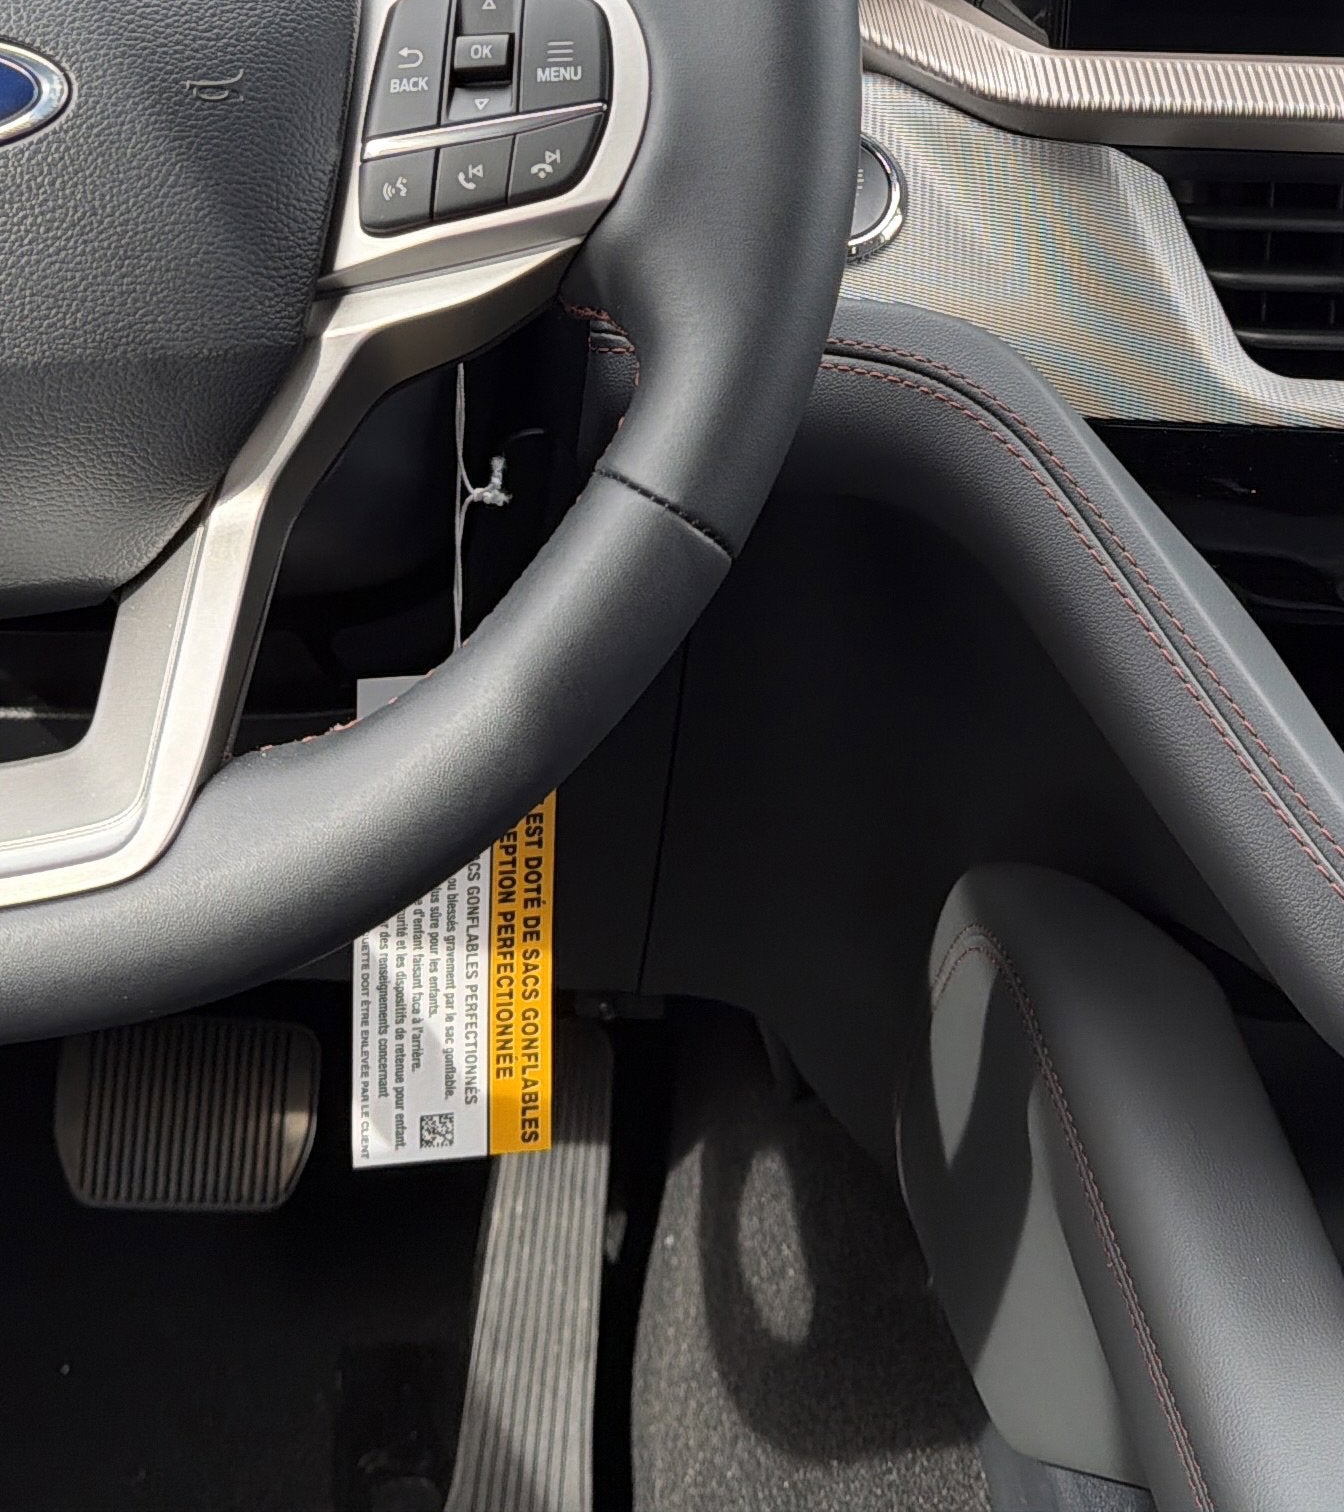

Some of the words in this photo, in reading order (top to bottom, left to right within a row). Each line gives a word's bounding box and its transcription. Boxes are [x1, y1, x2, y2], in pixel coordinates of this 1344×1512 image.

[470, 44, 492, 59] OK
[389, 76, 429, 94] BACK
[536, 66, 582, 82] MENU
[525, 813, 544, 849] EST
[498, 830, 517, 904] EPTION
[523, 856, 546, 910] DOTÉ
[430, 888, 441, 904] lus
[446, 893, 459, 931] blessés
[396, 912, 409, 938] urité
[413, 909, 426, 951] d'enfant
[430, 906, 442, 929] sûre
[466, 886, 480, 979] GONFLABLES
[522, 915, 541, 942] DE
[360, 937, 370, 971] UETTE
[378, 931, 391, 951] des
[396, 940, 407, 951] et
[427, 932, 439, 955] pour
[396, 954, 408, 969] les
[412, 954, 425, 990] faisant
[429, 958, 441, 974] les
[443, 935, 457, 990] gravement
[521, 948, 540, 1001] SACS
[360, 973, 370, 998] DOIT
[376, 953, 391, 1036] renseignements
[393, 972, 408, 1025] dispositifs
[429, 977, 441, 1018] enfants.
[443, 993, 455, 1009] par
[496, 910, 518, 1080] PERFECTIONNÉE
[360, 1000, 372, 1028] ÊTRE
[412, 992, 424, 1015] face
[445, 1013, 457, 1023] le
[395, 1028, 407, 1041] de
[411, 1027, 424, 1073] l'arrière.
[445, 1026, 455, 1045] sac
[464, 984, 481, 1106] PERFECTIONNÉS
[360, 1030, 372, 1078] ENLEVÉE
[378, 1038, 390, 1099] concernant
[394, 1043, 406, 1084] retenue
[442, 1048, 457, 1100] gonflable.
[521, 1007, 540, 1143] GONFLABLES
[360, 1081, 370, 1103] PAR
[392, 1086, 405, 1110] pour
[360, 1104, 370, 1120] LE
[360, 1121, 370, 1160] CLIENT
[394, 1113, 407, 1151] enfant.
